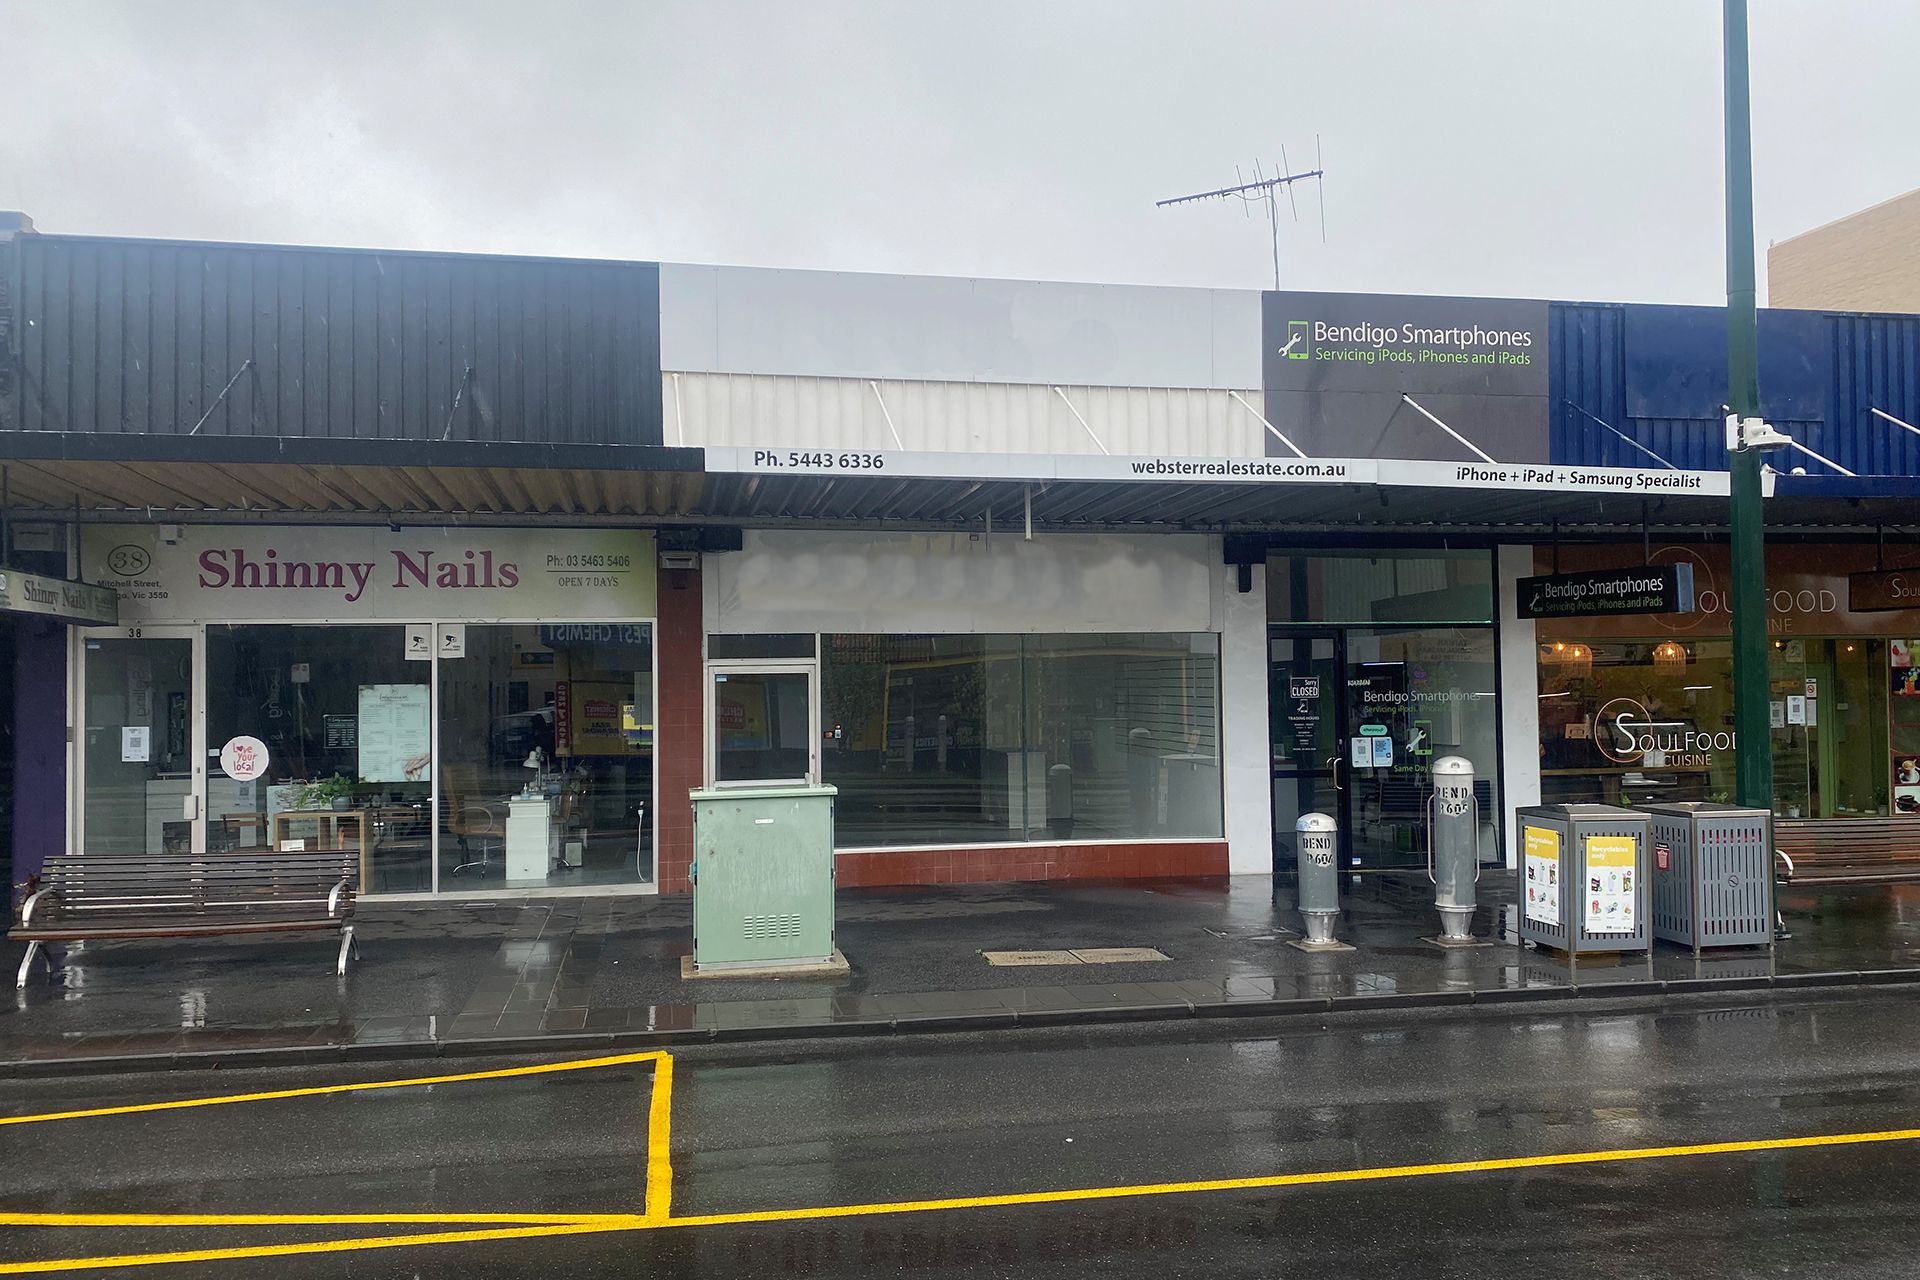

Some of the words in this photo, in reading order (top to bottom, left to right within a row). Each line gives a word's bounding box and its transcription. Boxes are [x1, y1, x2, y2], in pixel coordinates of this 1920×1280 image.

[1313, 322, 1398, 348] Bendigo
[1402, 323, 1532, 350] Smartphones
[1315, 347, 1375, 364] Servicing
[1378, 348, 1416, 363] iPods,
[1419, 349, 1468, 363] iPhones
[1471, 350, 1495, 364] and
[1498, 351, 1531, 365] iPads
[754, 450, 783, 467] Ph.
[788, 452, 834, 468] 5443
[838, 453, 884, 469] 6336
[1131, 459, 1346, 477] websterrealestate.com.au
[1456, 467, 1507, 482] iPhone
[1522, 468, 1554, 484] iPad
[1570, 471, 1633, 489] Samsung
[1636, 472, 1701, 489] Specialist
[113, 551, 144, 569] 38
[546, 555, 563, 567] Ph:
[566, 555, 578, 567] 03
[581, 555, 604, 567] 5463
[607, 555, 630, 567] 5406
[198, 548, 376, 602] Shinny
[390, 550, 520, 588] Nails
[558, 577, 583, 587] OPEN
[586, 577, 591, 587] 7
[97, 580, 131, 588] Mitchell
[1545, 581, 1587, 600] Bendigo
[1588, 575, 1664, 597] Smartphones
[24, 580, 58, 611] Shinny
[62, 586, 87, 609] Nails
[131, 591, 146, 599] Vic
[148, 591, 169, 599] 3550
[1545, 601, 1576, 613] Servicing
[1627, 597, 1641, 608] and
[1642, 595, 1663, 607] iPads
[128, 627, 142, 638] 38
[1292, 687, 1318, 697] CLOSED
[1363, 691, 1409, 705] Bendigo
[1411, 690, 1480, 703] Smartphones
[1364, 705, 1397, 714] Servicing
[1664, 754, 1712, 767] CUISINE
[1414, 765, 1428, 773] Day
[1303, 837, 1331, 849] BEND
